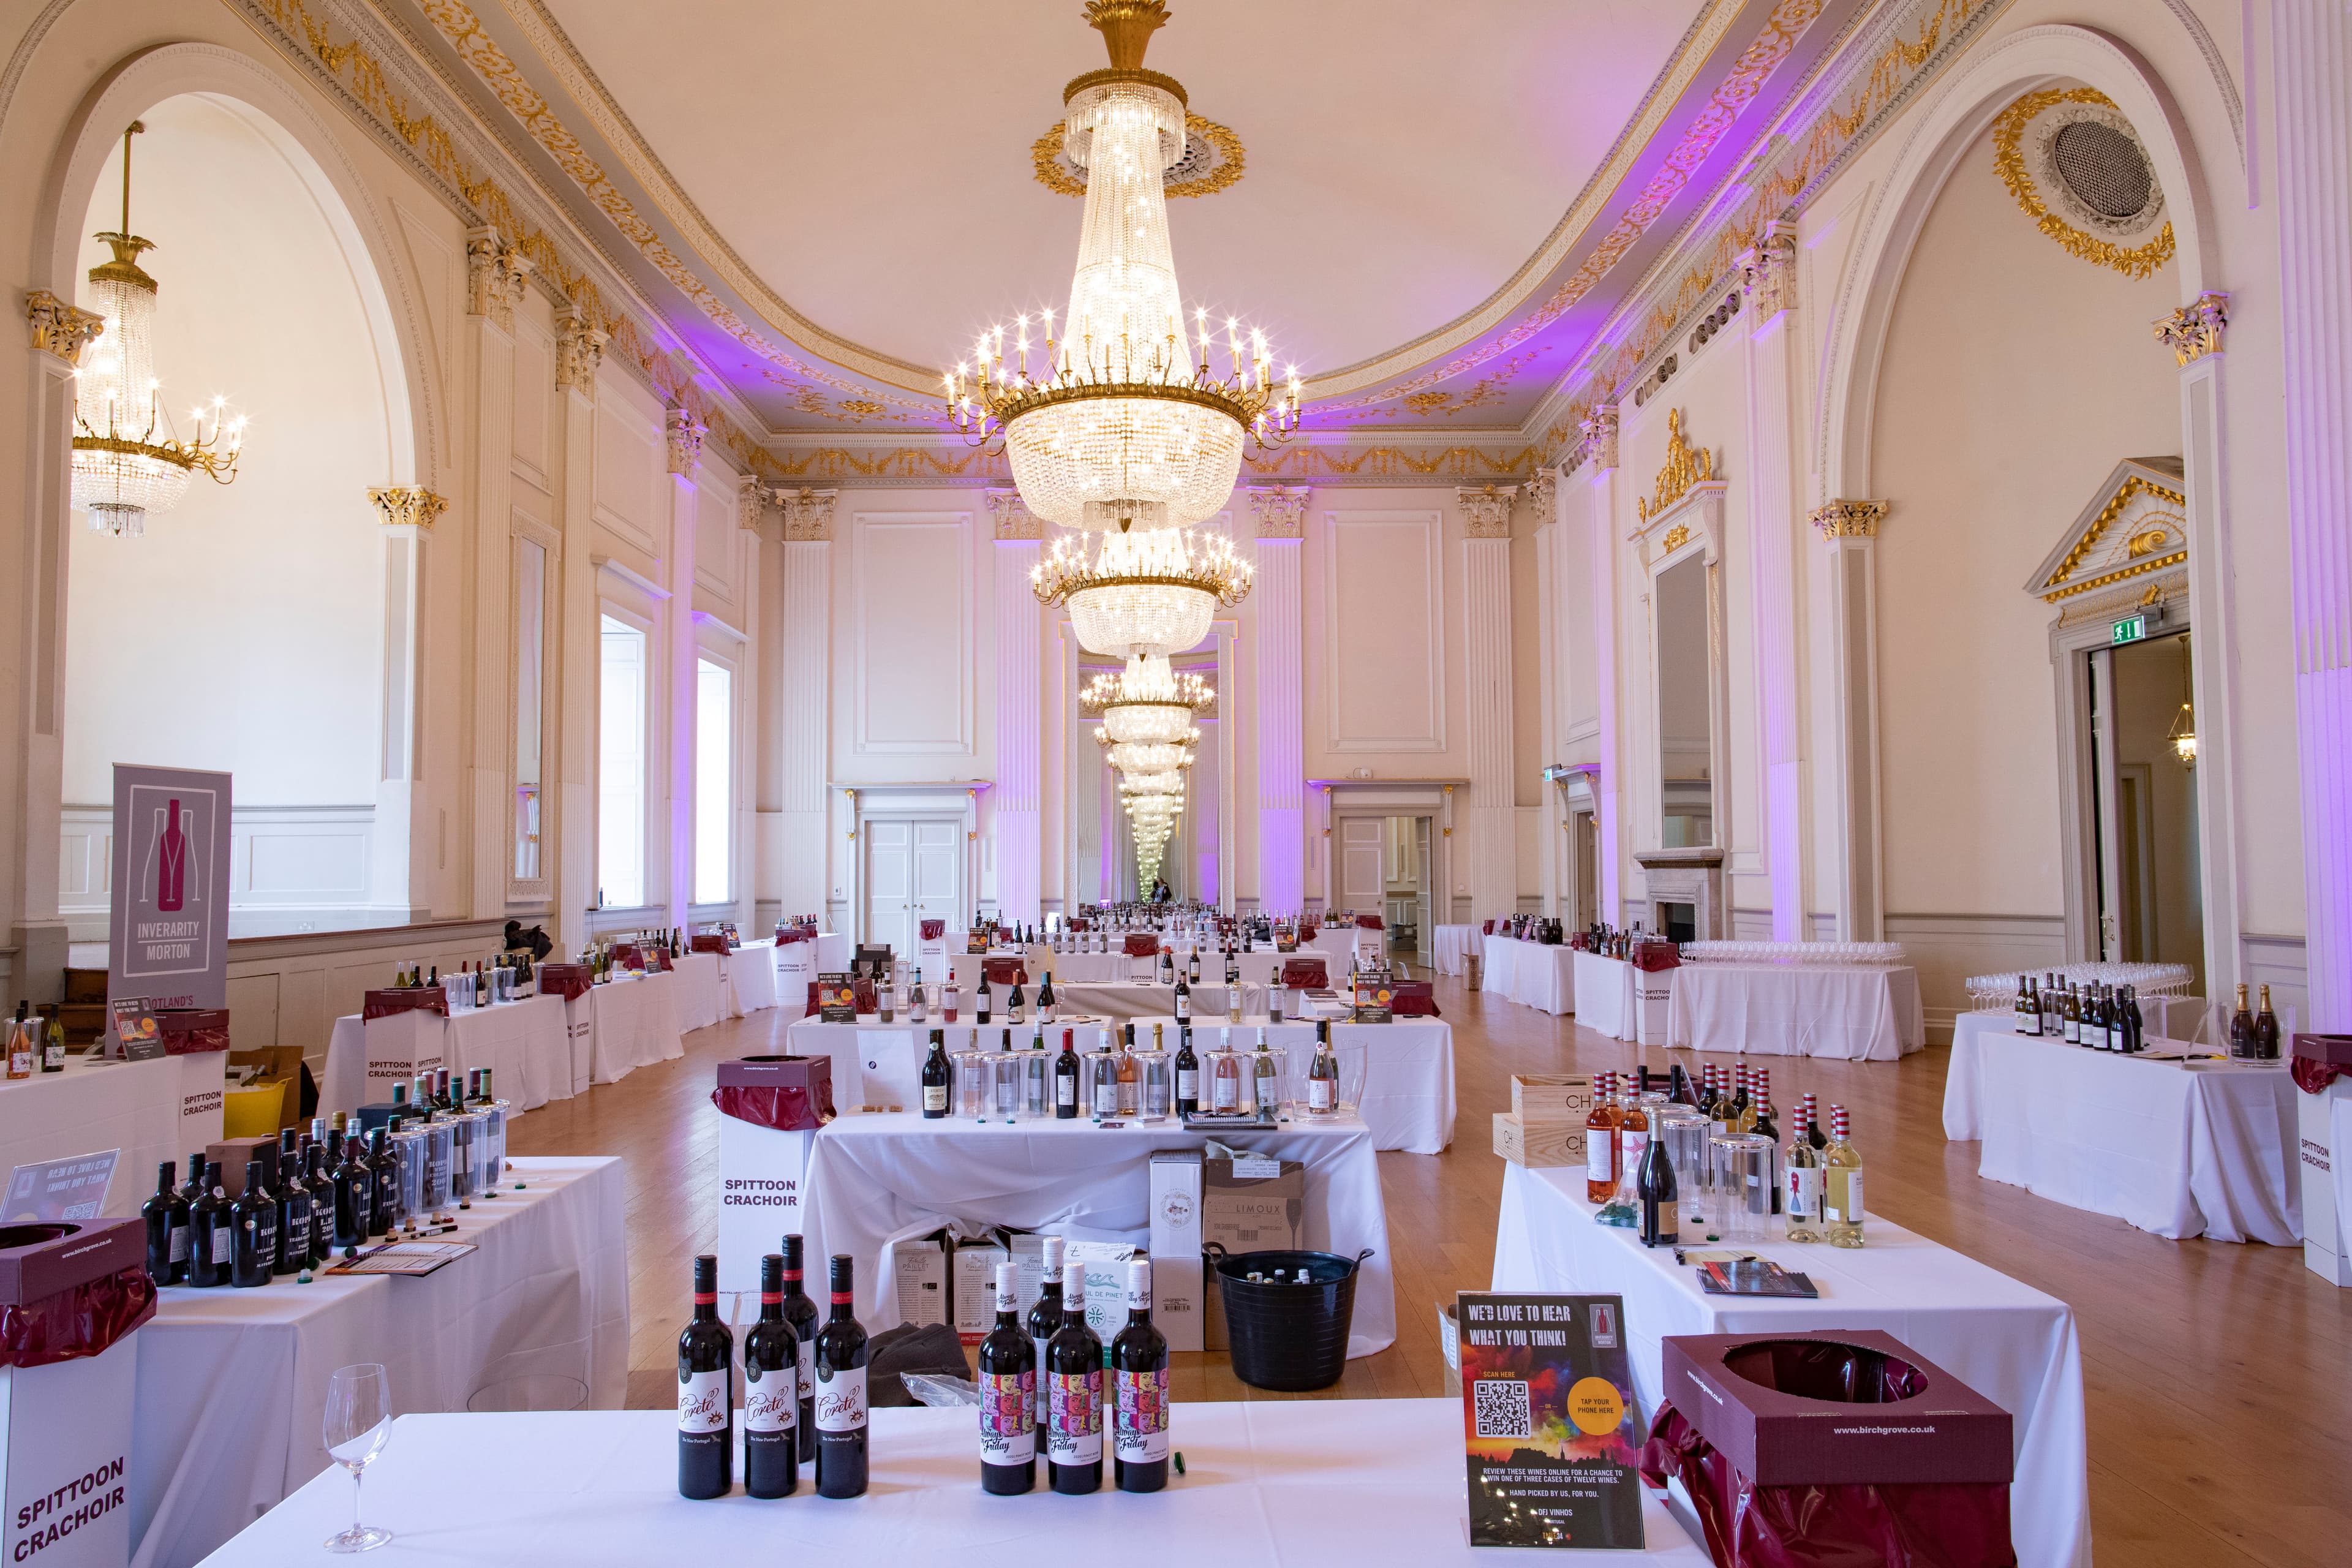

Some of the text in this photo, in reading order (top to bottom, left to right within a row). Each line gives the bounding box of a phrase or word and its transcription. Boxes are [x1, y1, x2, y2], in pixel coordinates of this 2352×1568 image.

[138, 921, 200, 938] INVERARITY
[146, 944, 190, 960] MORTON
[151, 995, 194, 1009] OTLAND'S
[418, 1056, 442, 1068] SPITTOON
[184, 1090, 222, 1105] SPITTOON
[1566, 1095, 1591, 1109] CH
[183, 1101, 222, 1116] CRACHOIR
[1504, 1130, 1513, 1146] CH
[2301, 1138, 2329, 1158] SPITTOON
[2301, 1153, 2331, 1172] CRACHOIR
[725, 1180, 796, 1191] SPITTOON
[724, 1195, 797, 1206] CRACHOIR
[1236, 1205, 1280, 1213] LIMOUX
[62, 1238, 112, 1259] www.birchgrove.co.uk
[1468, 1305, 1571, 1322] WE'D LOVE TO HEAR
[1469, 1329, 1566, 1346] WHAT YOU THINK!
[1687, 1370, 1723, 1406] www.birchgrove.co.uk
[679, 1388, 719, 1422] Coreto
[745, 1386, 789, 1422] Coreto
[817, 1385, 860, 1422] Coreto
[1833, 1425, 1936, 1435] www.birchgrove.co.uk
[984, 1439, 1010, 1453] Friday
[1051, 1439, 1077, 1453] Friday
[1120, 1436, 1148, 1452] Friday
[17, 1456, 124, 1529] SPITTOON
[14, 1487, 124, 1562] CRACHOIR
